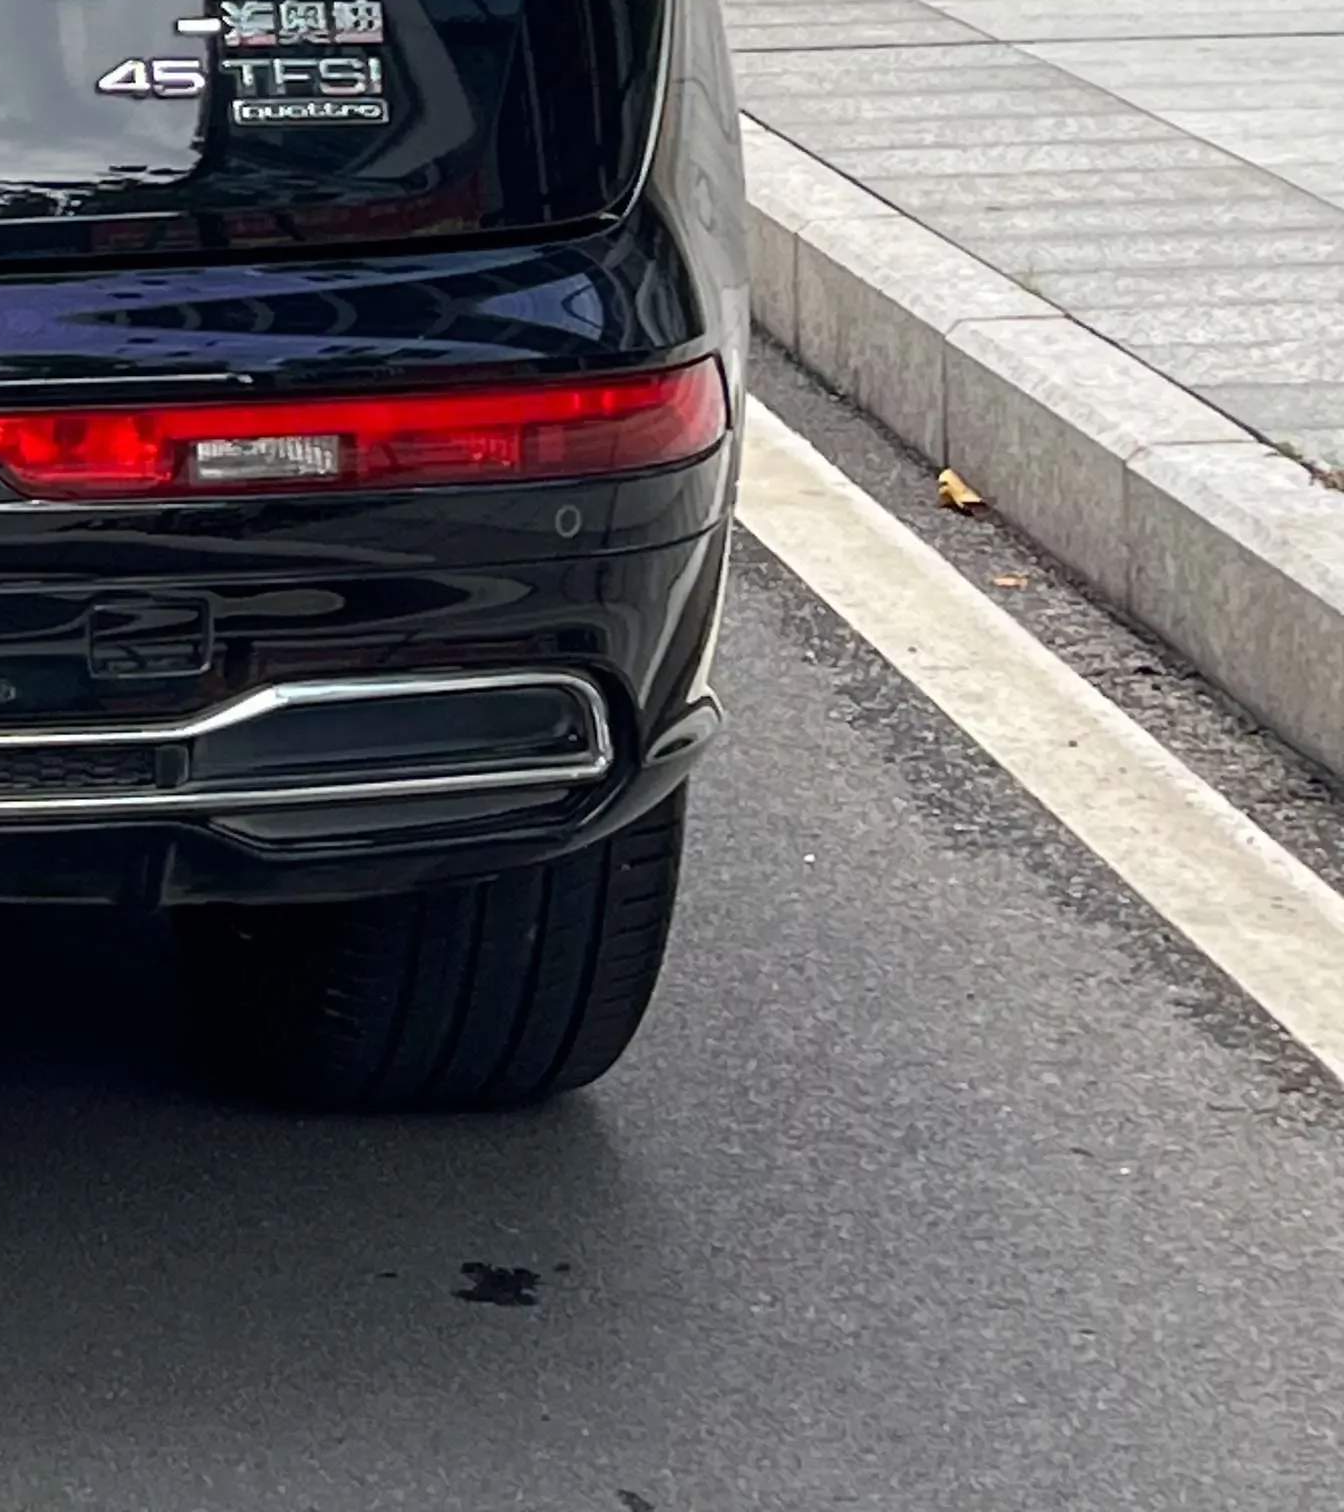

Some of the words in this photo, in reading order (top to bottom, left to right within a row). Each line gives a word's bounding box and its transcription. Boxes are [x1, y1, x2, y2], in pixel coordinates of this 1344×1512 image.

[97, 58, 207, 96] 45
[221, 57, 383, 96] TFSI
[238, 100, 384, 121] quattro
